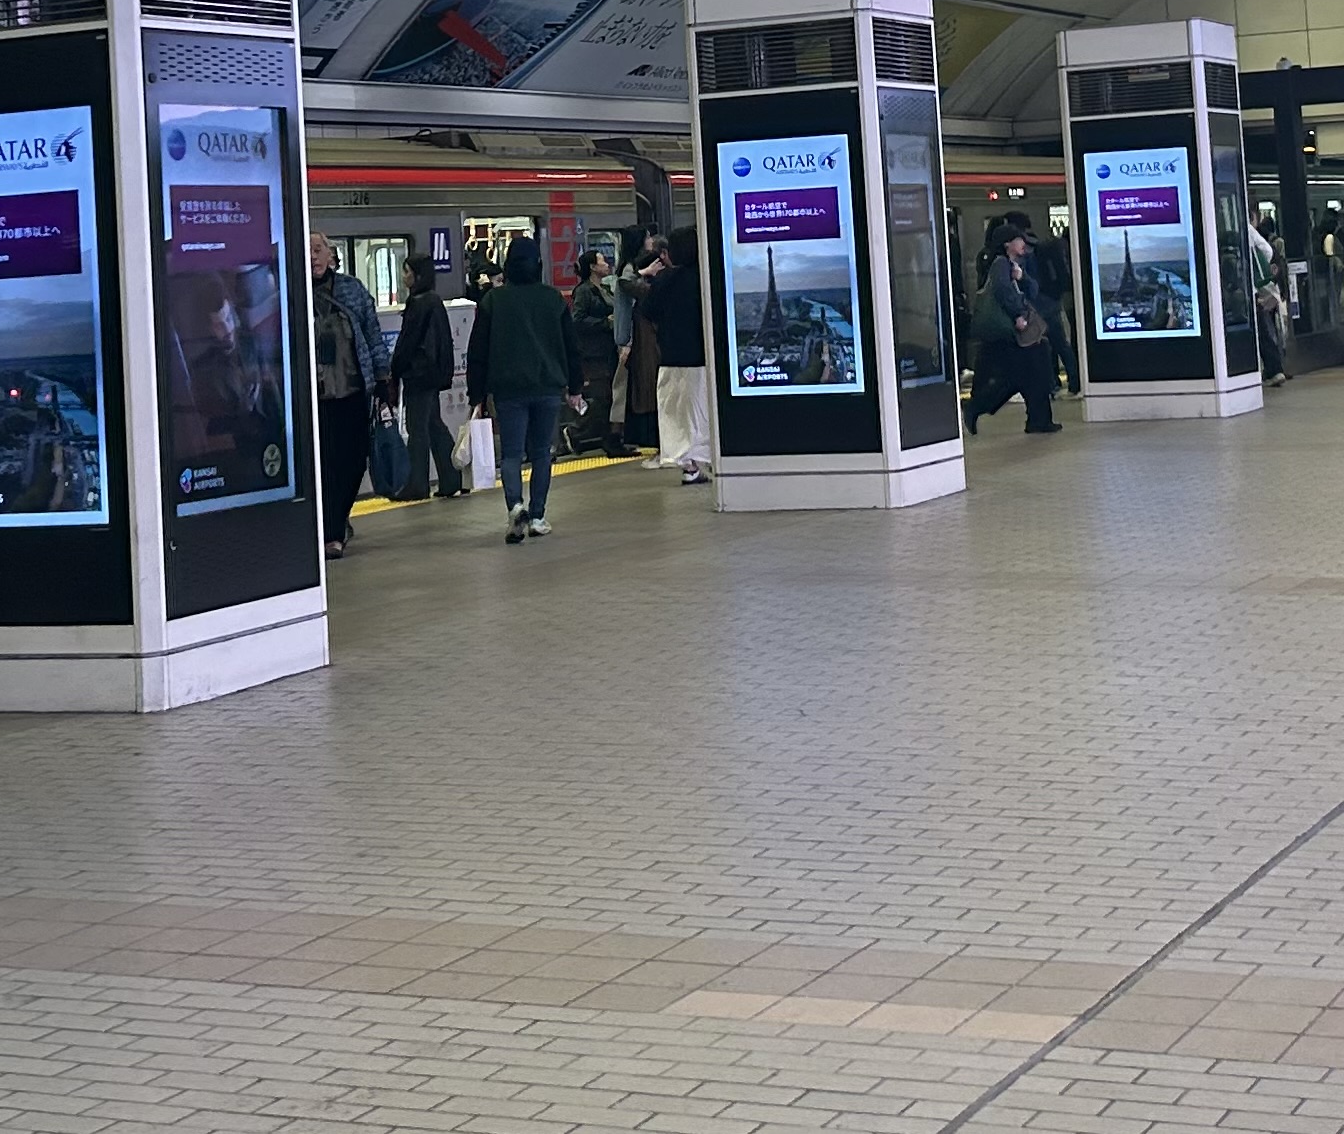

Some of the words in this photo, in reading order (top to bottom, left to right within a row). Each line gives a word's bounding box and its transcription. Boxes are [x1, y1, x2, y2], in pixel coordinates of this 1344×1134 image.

[198, 132, 250, 157] QATAR
[763, 153, 816, 172] QATAR
[1119, 161, 1161, 175] QATAR
